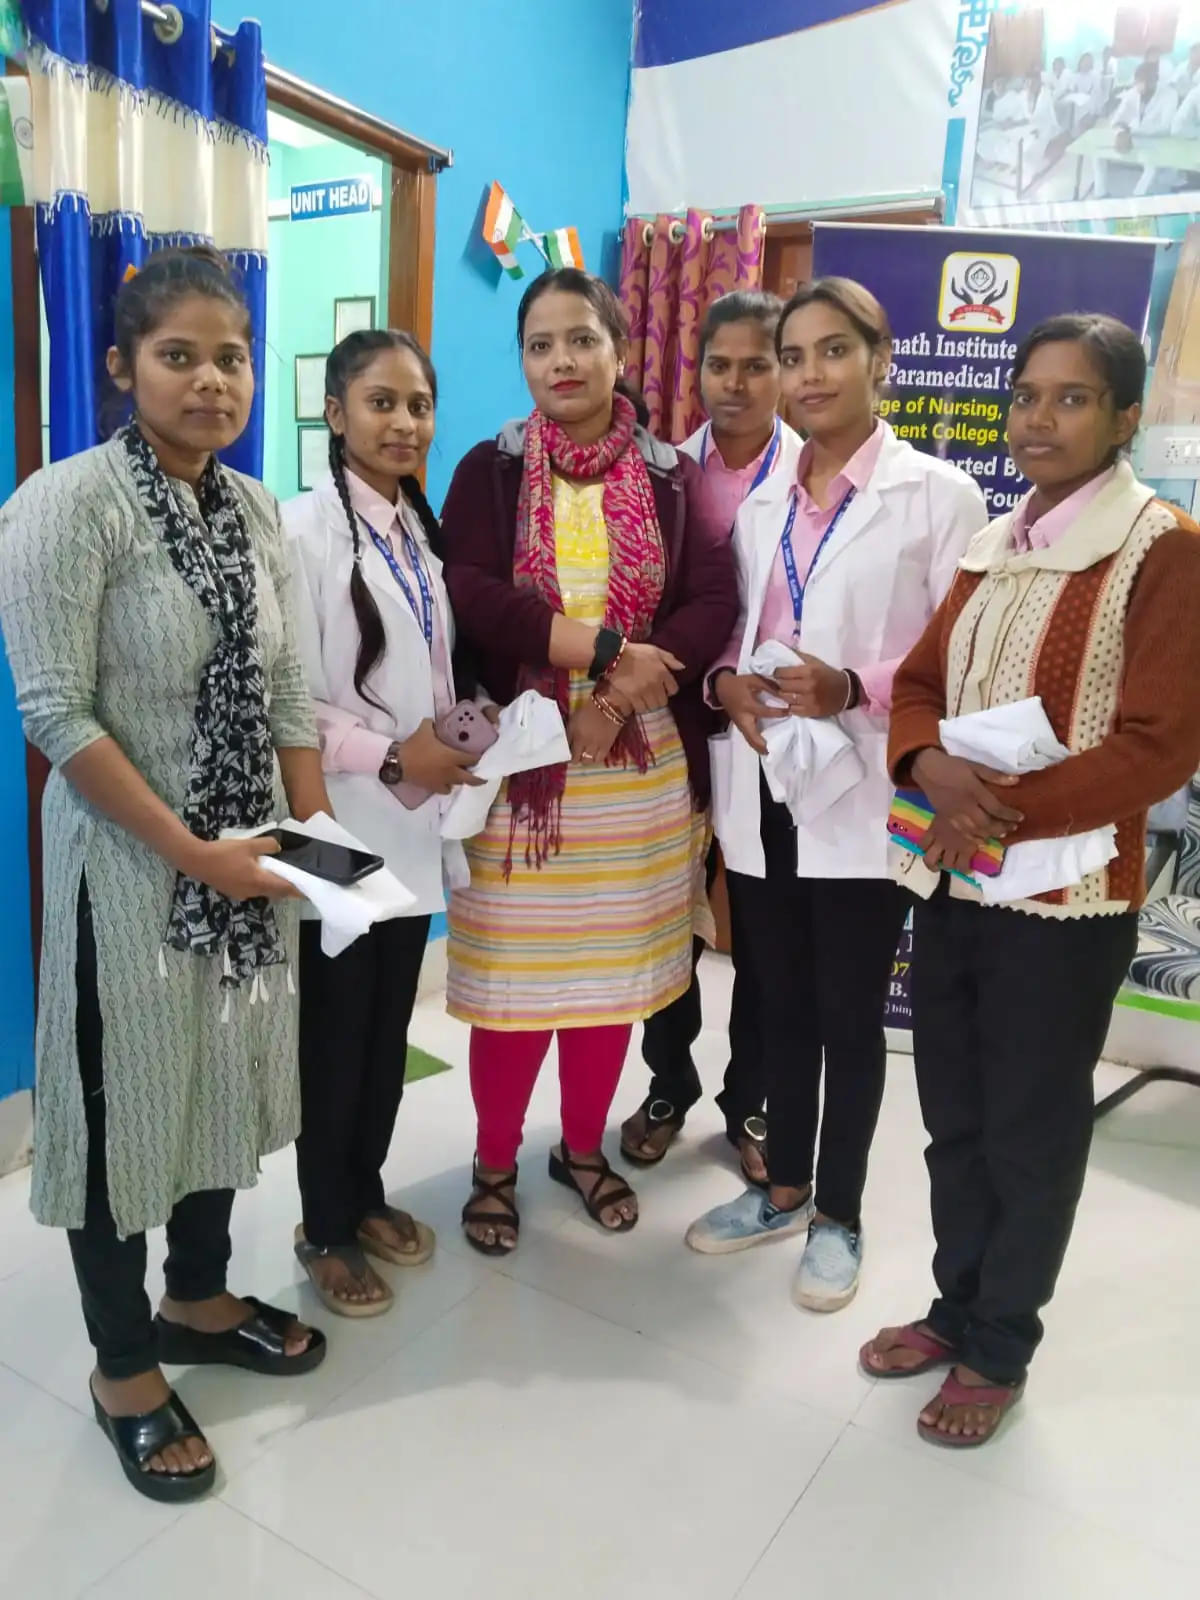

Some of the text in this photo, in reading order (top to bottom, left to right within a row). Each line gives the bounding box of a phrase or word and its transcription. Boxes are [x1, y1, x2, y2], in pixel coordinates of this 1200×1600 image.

[292, 183, 369, 213] UNIT HEAD
[935, 334, 1017, 360] Institute
[885, 362, 1001, 390] Paramedical
[905, 396, 926, 414] of
[928, 398, 1003, 421] Nursing,
[932, 422, 999, 446] College
[947, 455, 998, 476] rted
[983, 487, 1026, 508] Fou
